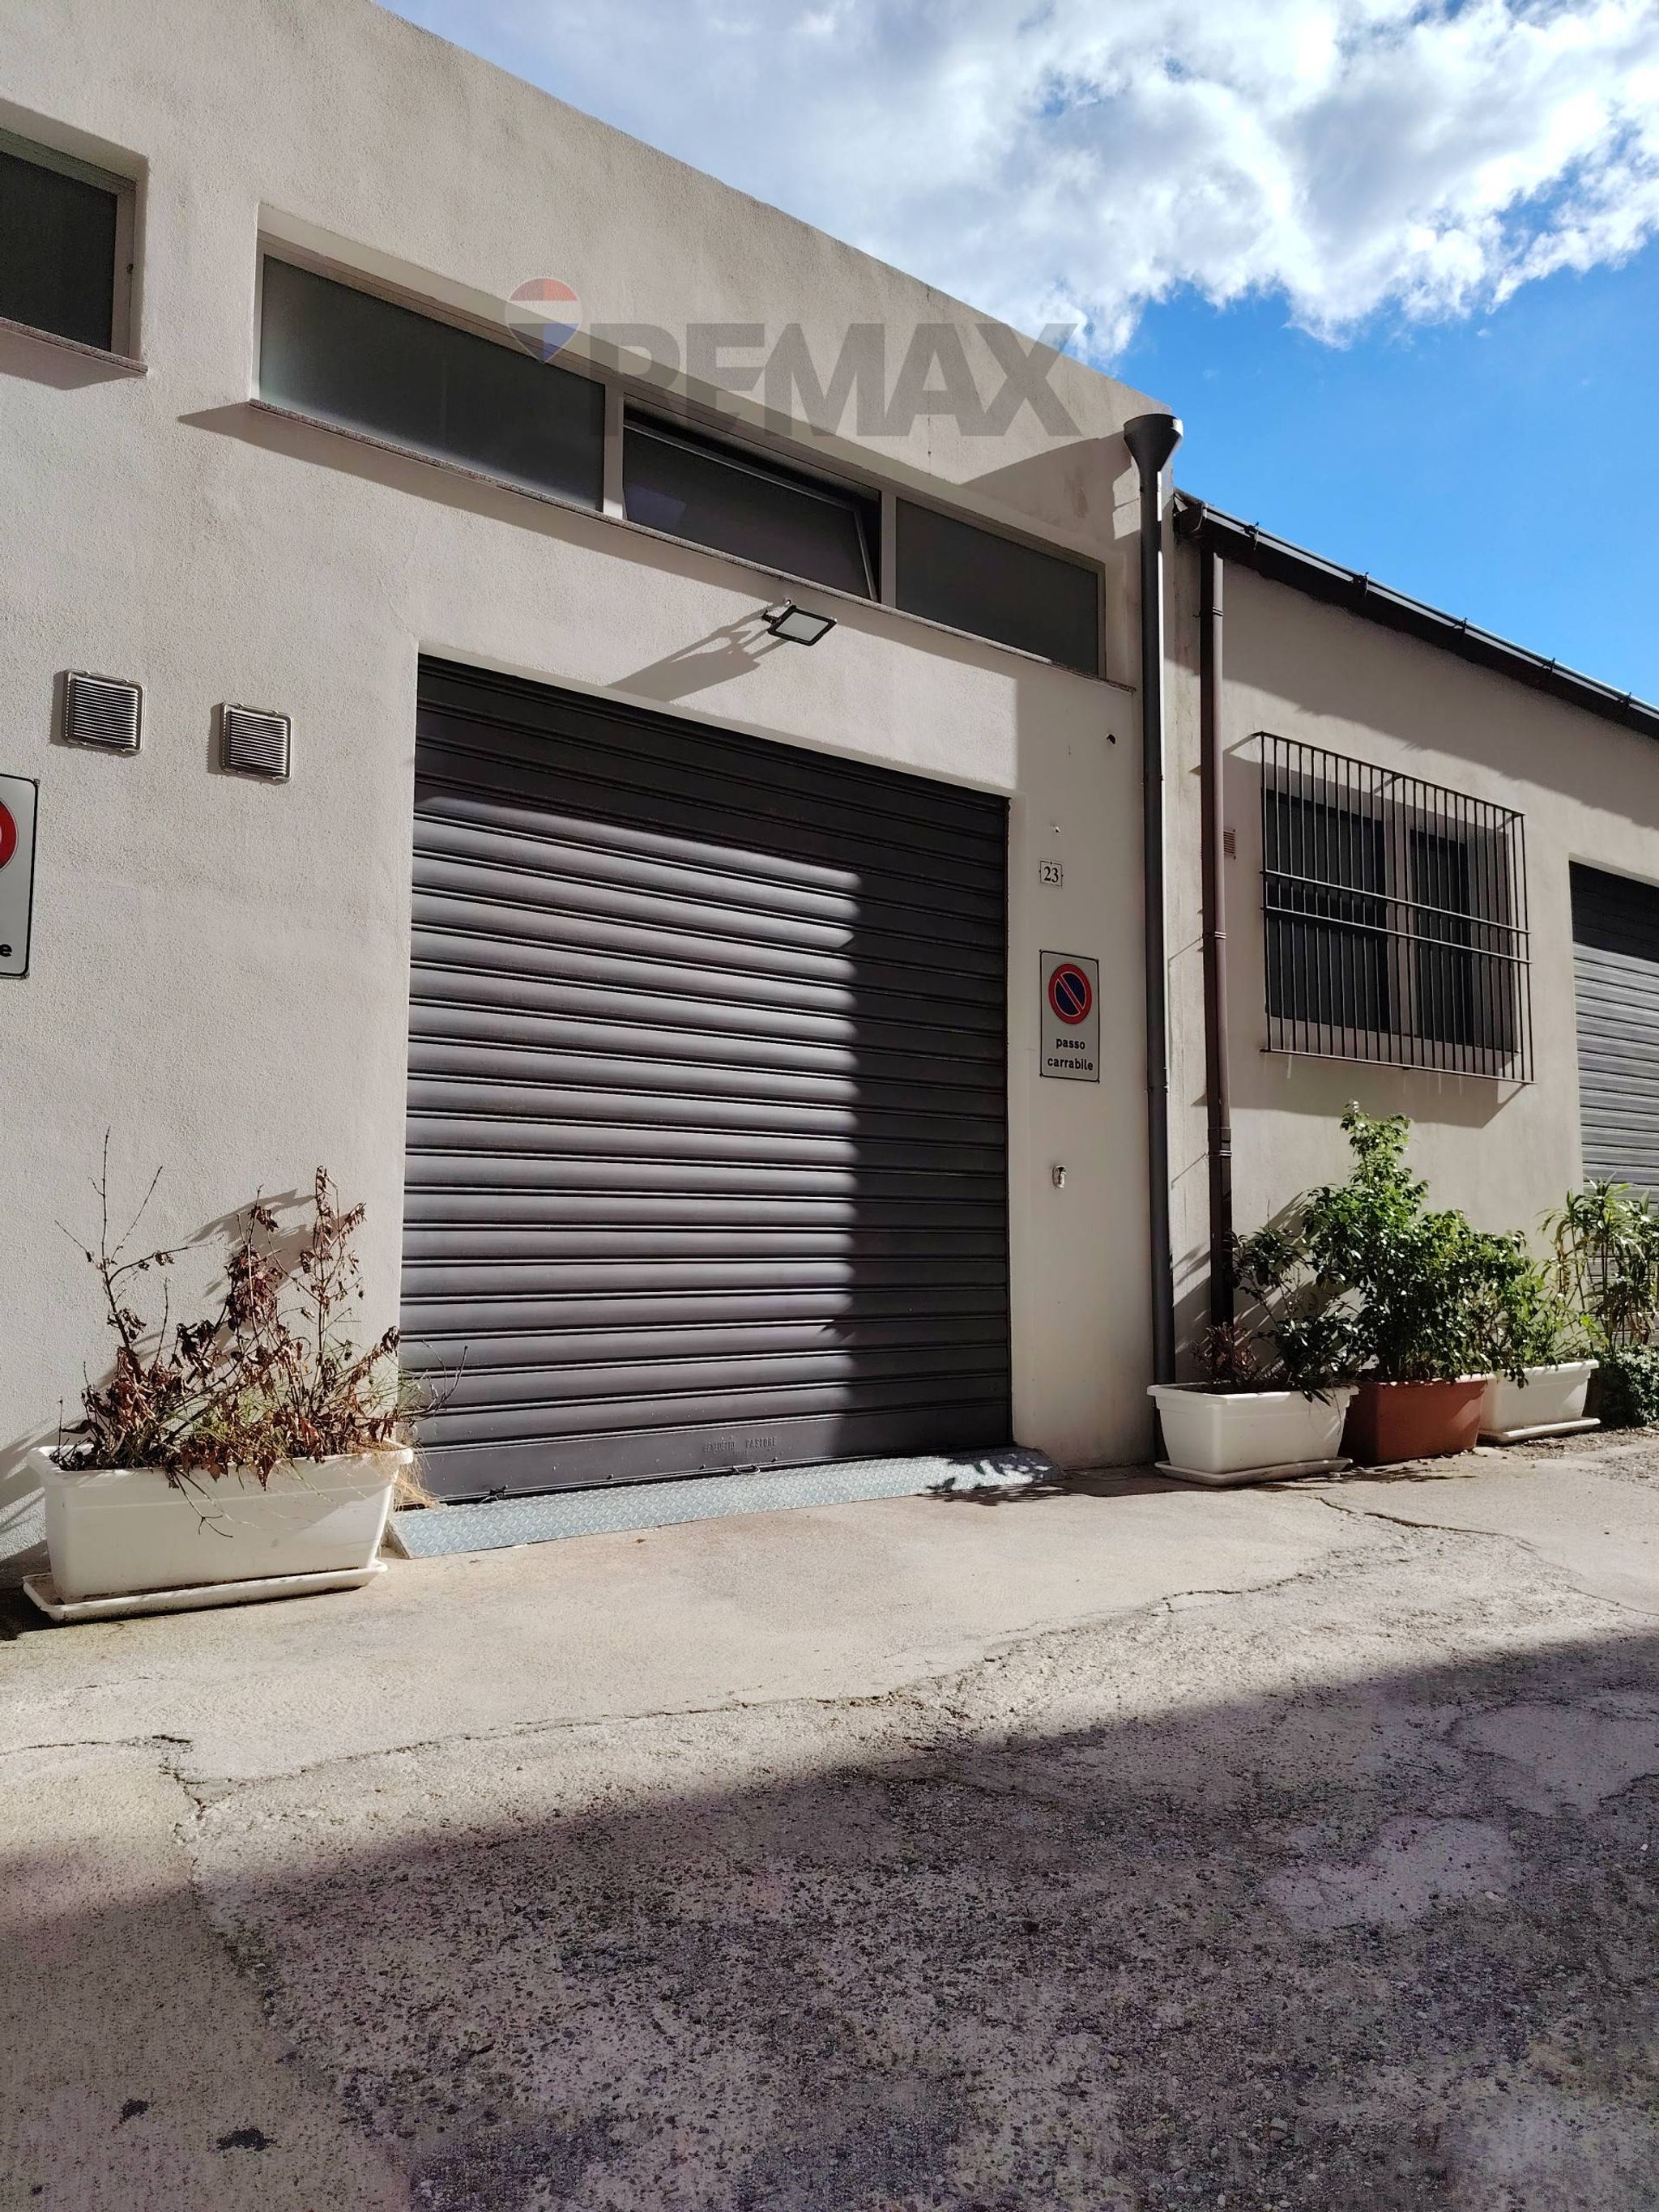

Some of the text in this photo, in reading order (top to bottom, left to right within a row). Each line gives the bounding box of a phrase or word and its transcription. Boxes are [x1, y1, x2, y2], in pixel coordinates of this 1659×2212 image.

[1043, 866, 1060, 883] 23
[1056, 1038, 1085, 1050] passo
[1047, 1057, 1094, 1071] carrabile
